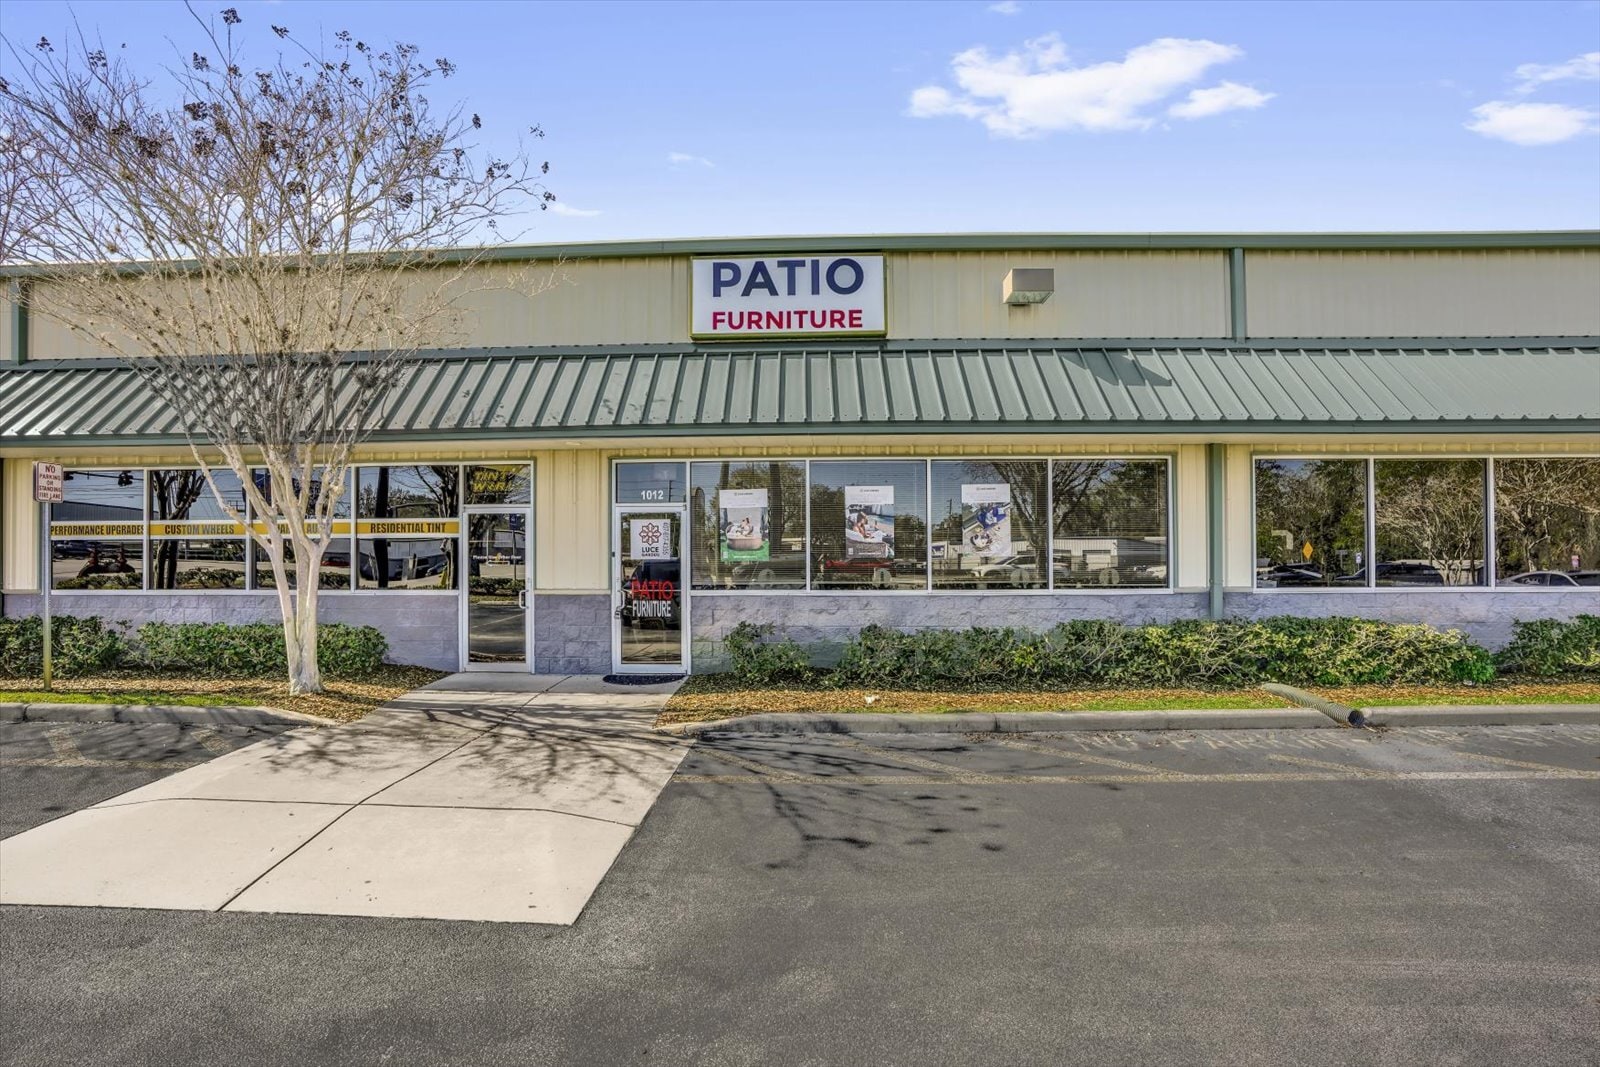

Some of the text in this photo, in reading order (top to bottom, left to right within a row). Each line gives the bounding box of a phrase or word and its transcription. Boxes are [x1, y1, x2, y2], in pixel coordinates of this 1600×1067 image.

[712, 258, 864, 297] PATIO
[712, 309, 863, 330] FURNITURE
[45, 465, 55, 473] NO
[641, 490, 664, 500] 1012
[51, 525, 144, 535] PERFORMANCE UPGRADES
[165, 524, 234, 535] CUSTOM WHEELS
[370, 522, 446, 534] RESIDENTIAL TINT
[631, 579, 673, 600] PATIO
[632, 601, 671, 617] FURNITURE
